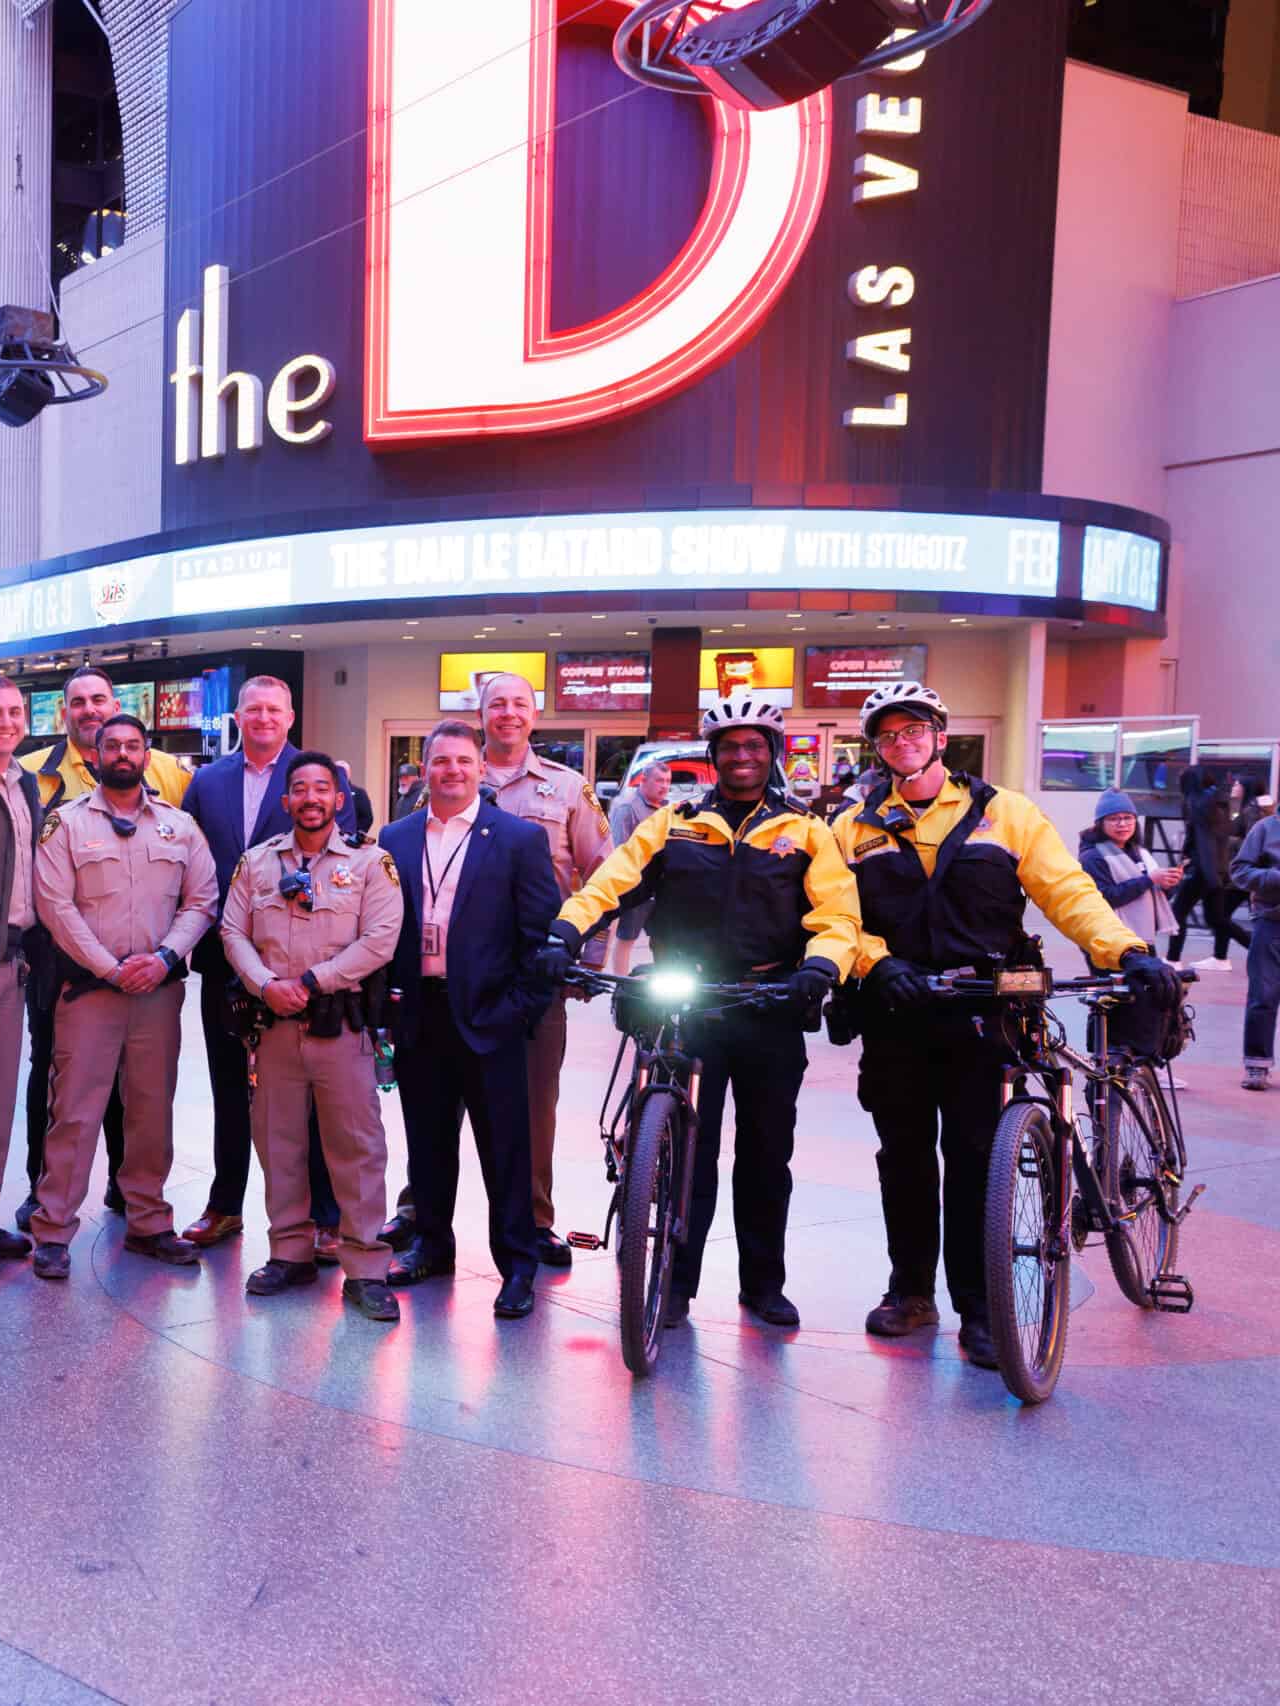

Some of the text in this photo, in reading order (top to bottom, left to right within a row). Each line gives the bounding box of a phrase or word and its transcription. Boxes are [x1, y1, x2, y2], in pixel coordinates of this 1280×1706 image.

[170, 0, 834, 465] the D
[843, 265, 915, 427] LAS
[180, 551, 284, 577] STADIUM
[330, 541, 388, 588] THE
[472, 532, 513, 581] LE
[671, 524, 787, 576] SHOW
[794, 529, 863, 568] WITH
[865, 531, 969, 573] STUGOTZ
[560, 665, 646, 677] COFFEE STAND
[829, 660, 865, 672] OPEN
